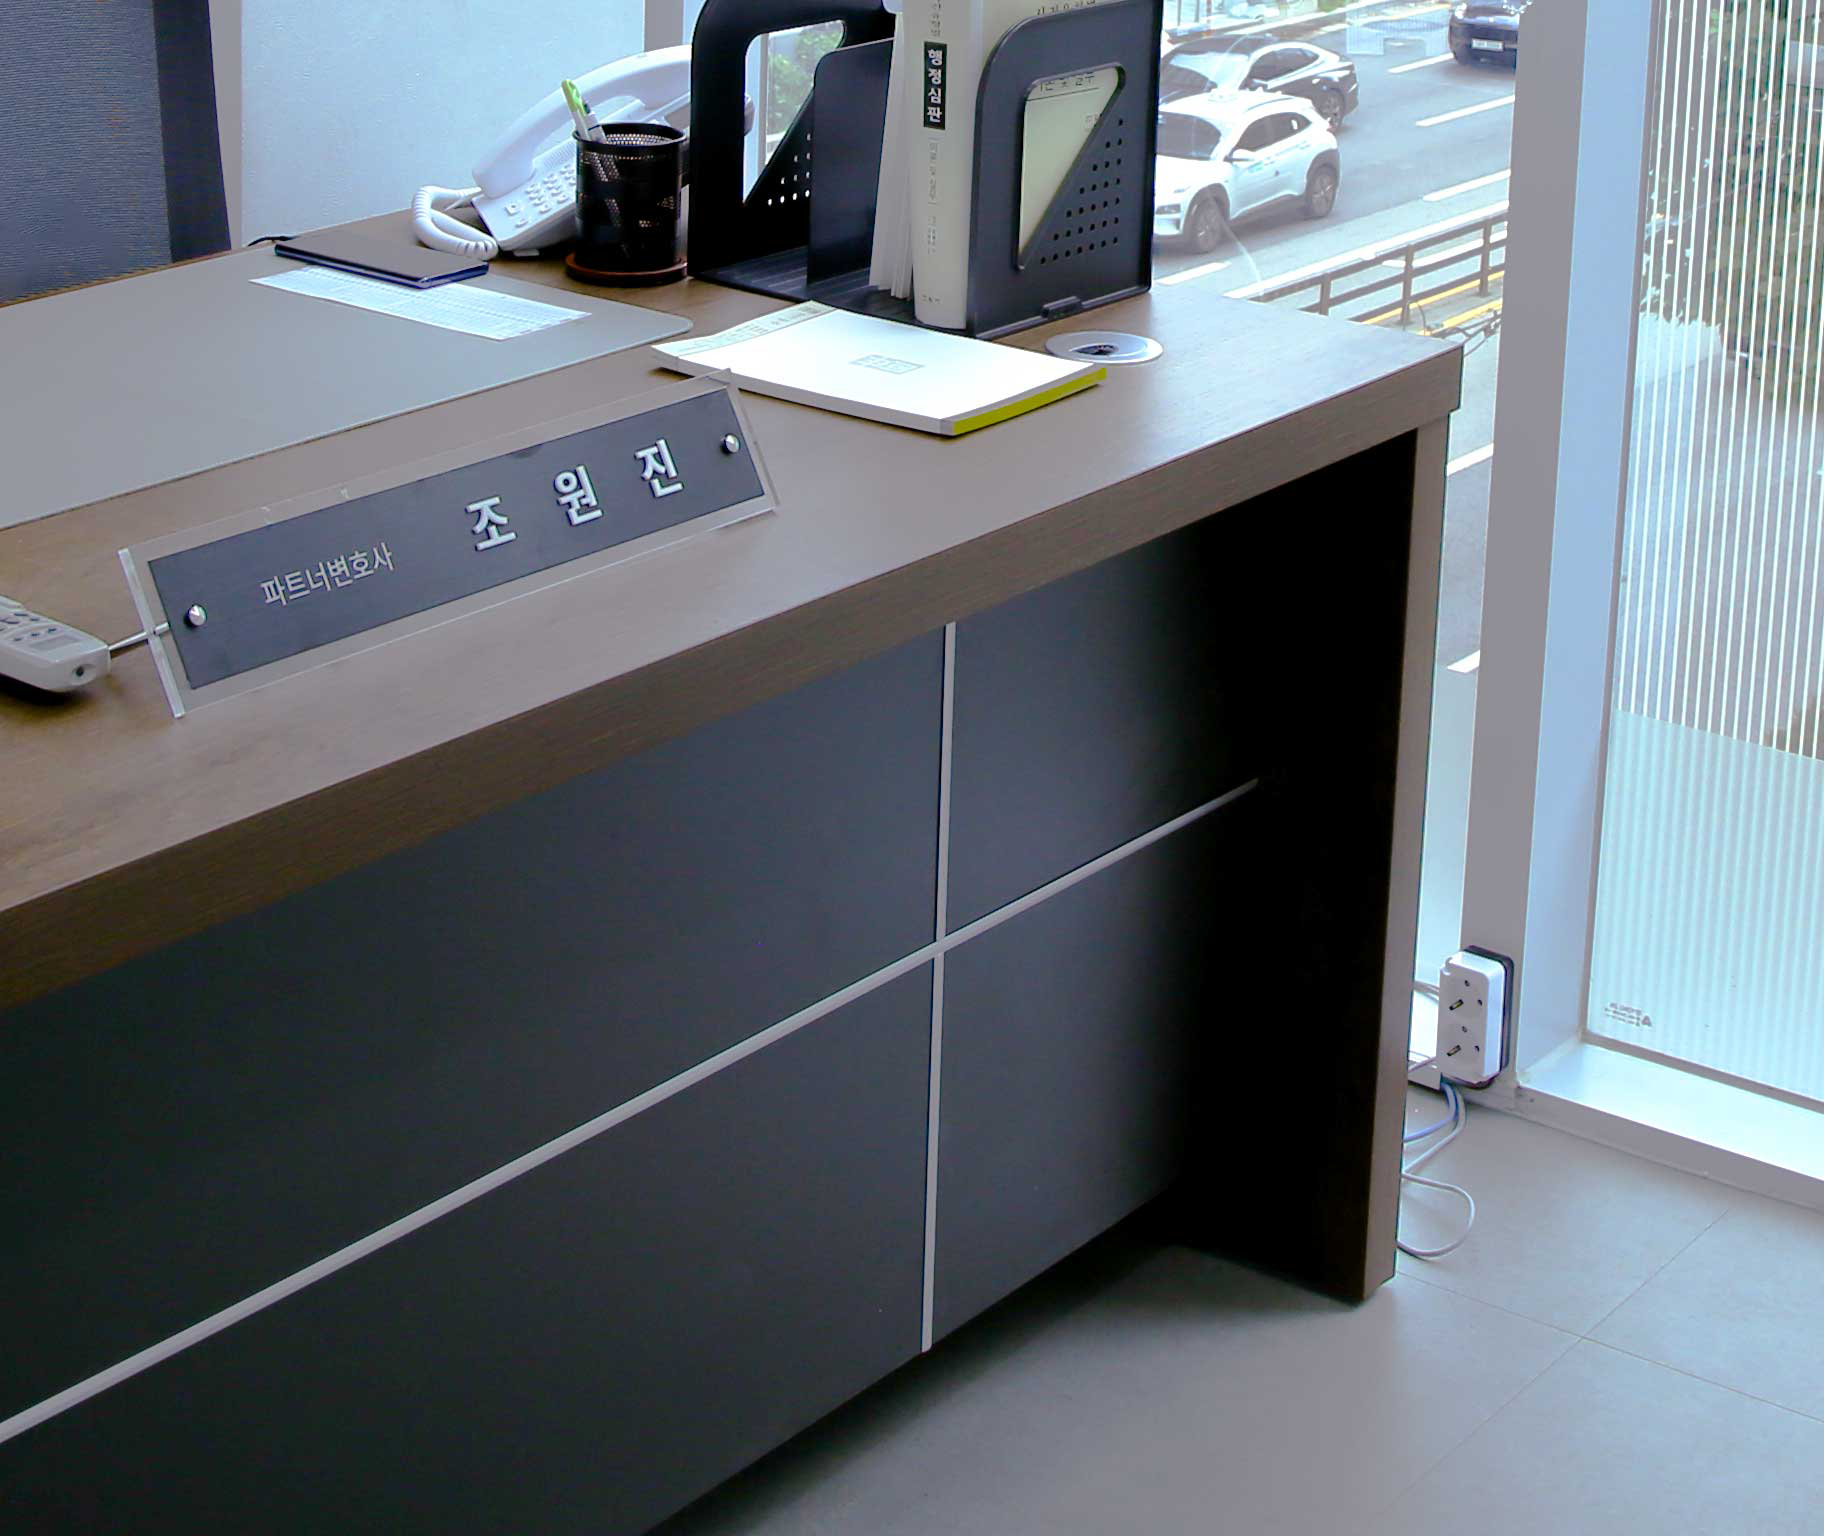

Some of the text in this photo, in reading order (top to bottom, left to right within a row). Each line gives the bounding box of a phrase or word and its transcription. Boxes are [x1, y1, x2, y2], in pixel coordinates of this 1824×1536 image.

[926, 48, 944, 125] 행정심판
[259, 438, 686, 606] 파트너변호사 조원진
